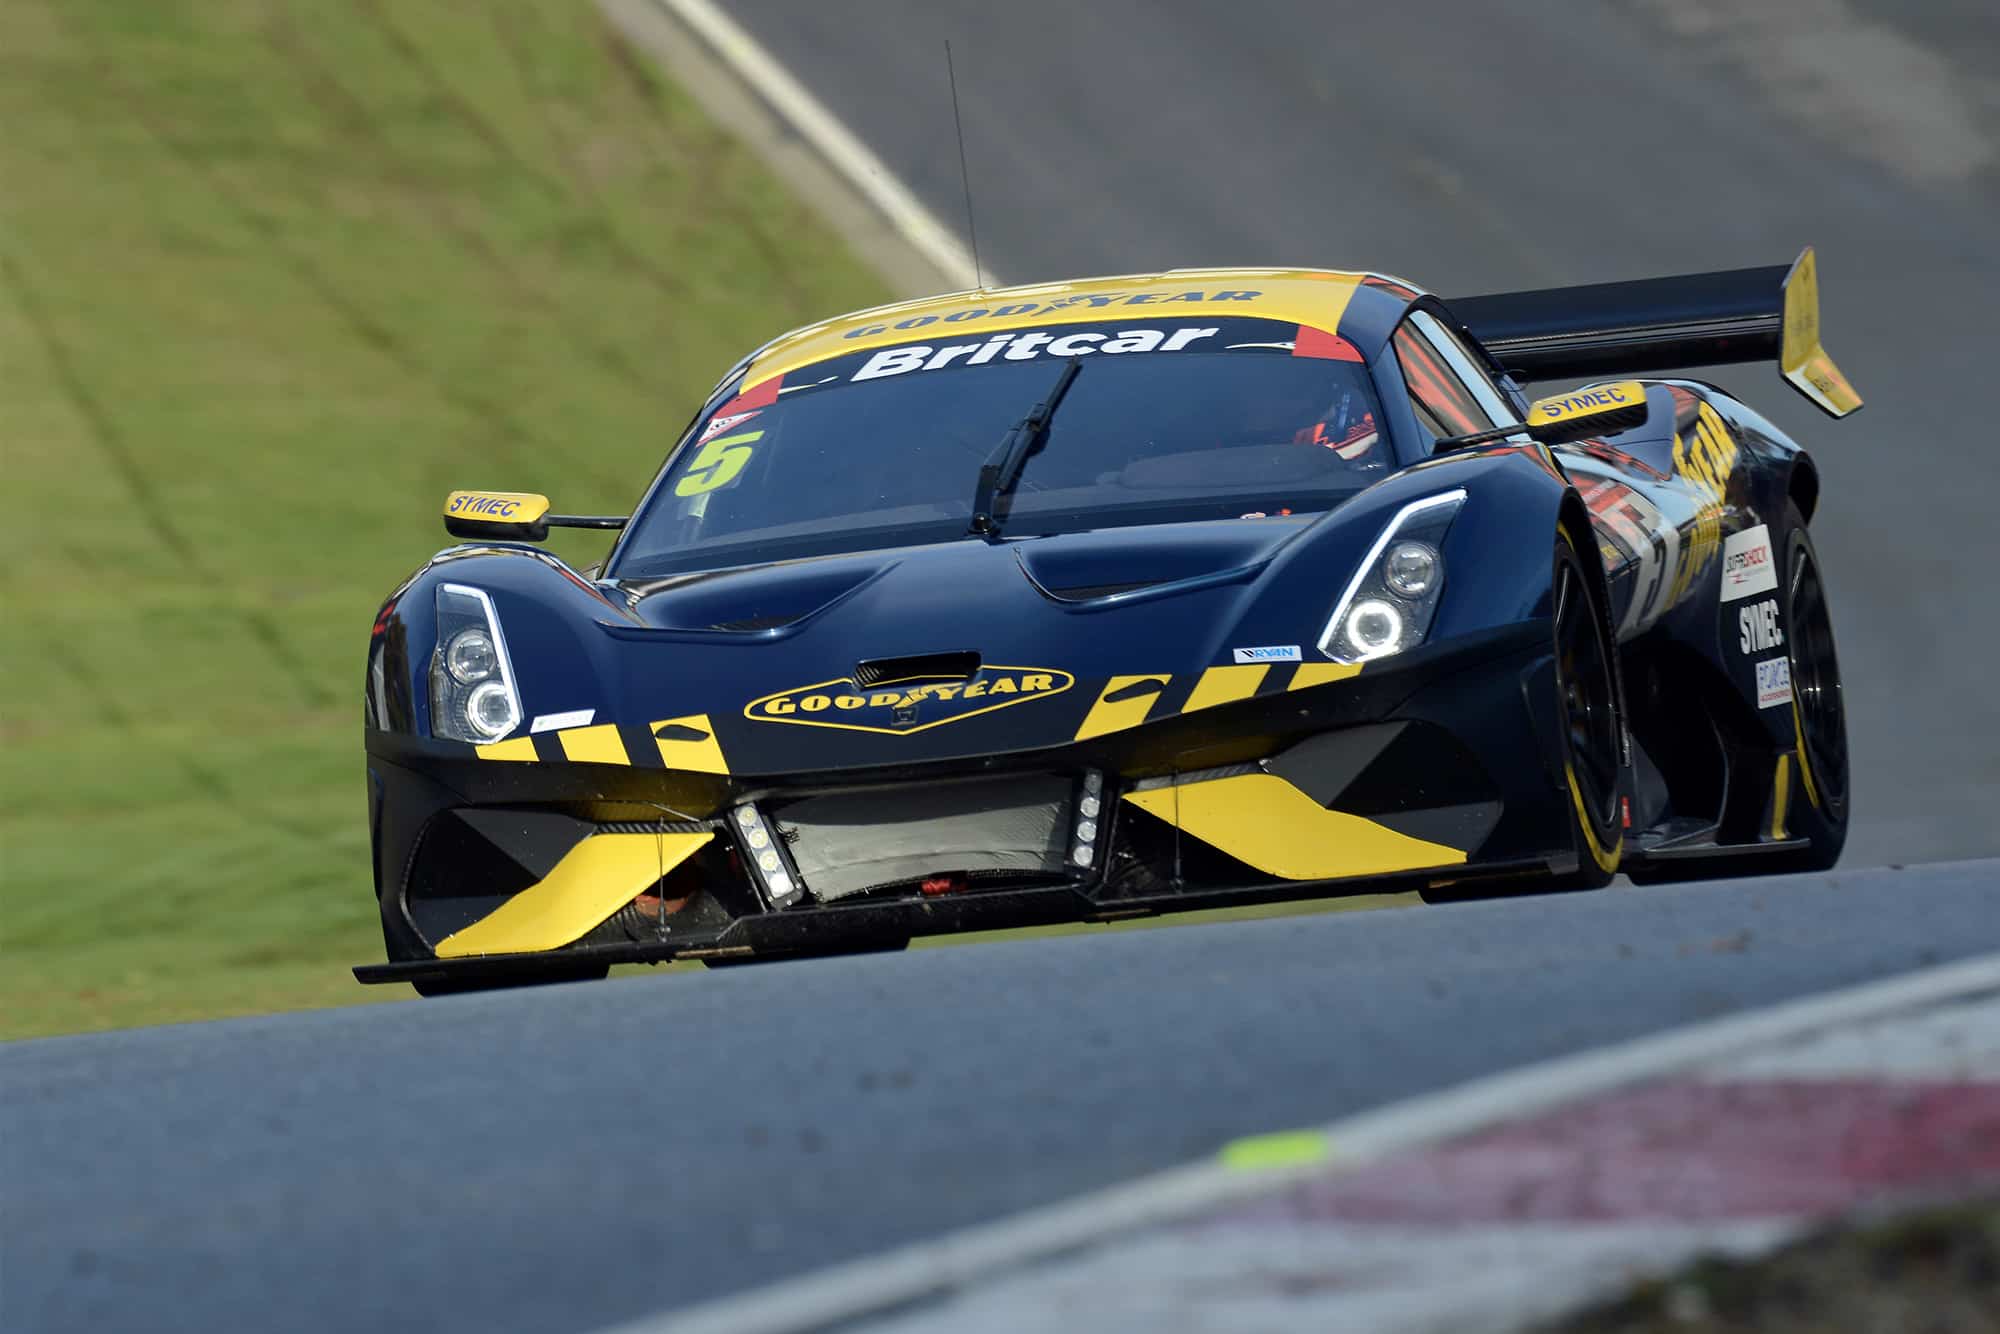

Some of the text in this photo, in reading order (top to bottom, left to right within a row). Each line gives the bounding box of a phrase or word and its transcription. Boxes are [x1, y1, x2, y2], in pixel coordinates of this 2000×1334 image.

[842, 290, 1262, 340] GOODYEAR
[850, 327, 1220, 382] Britcar
[1541, 387, 1625, 417] SYMEC
[675, 430, 765, 497] 5
[450, 495, 520, 516] SYMEC
[764, 674, 1053, 715] GOODYEAR
